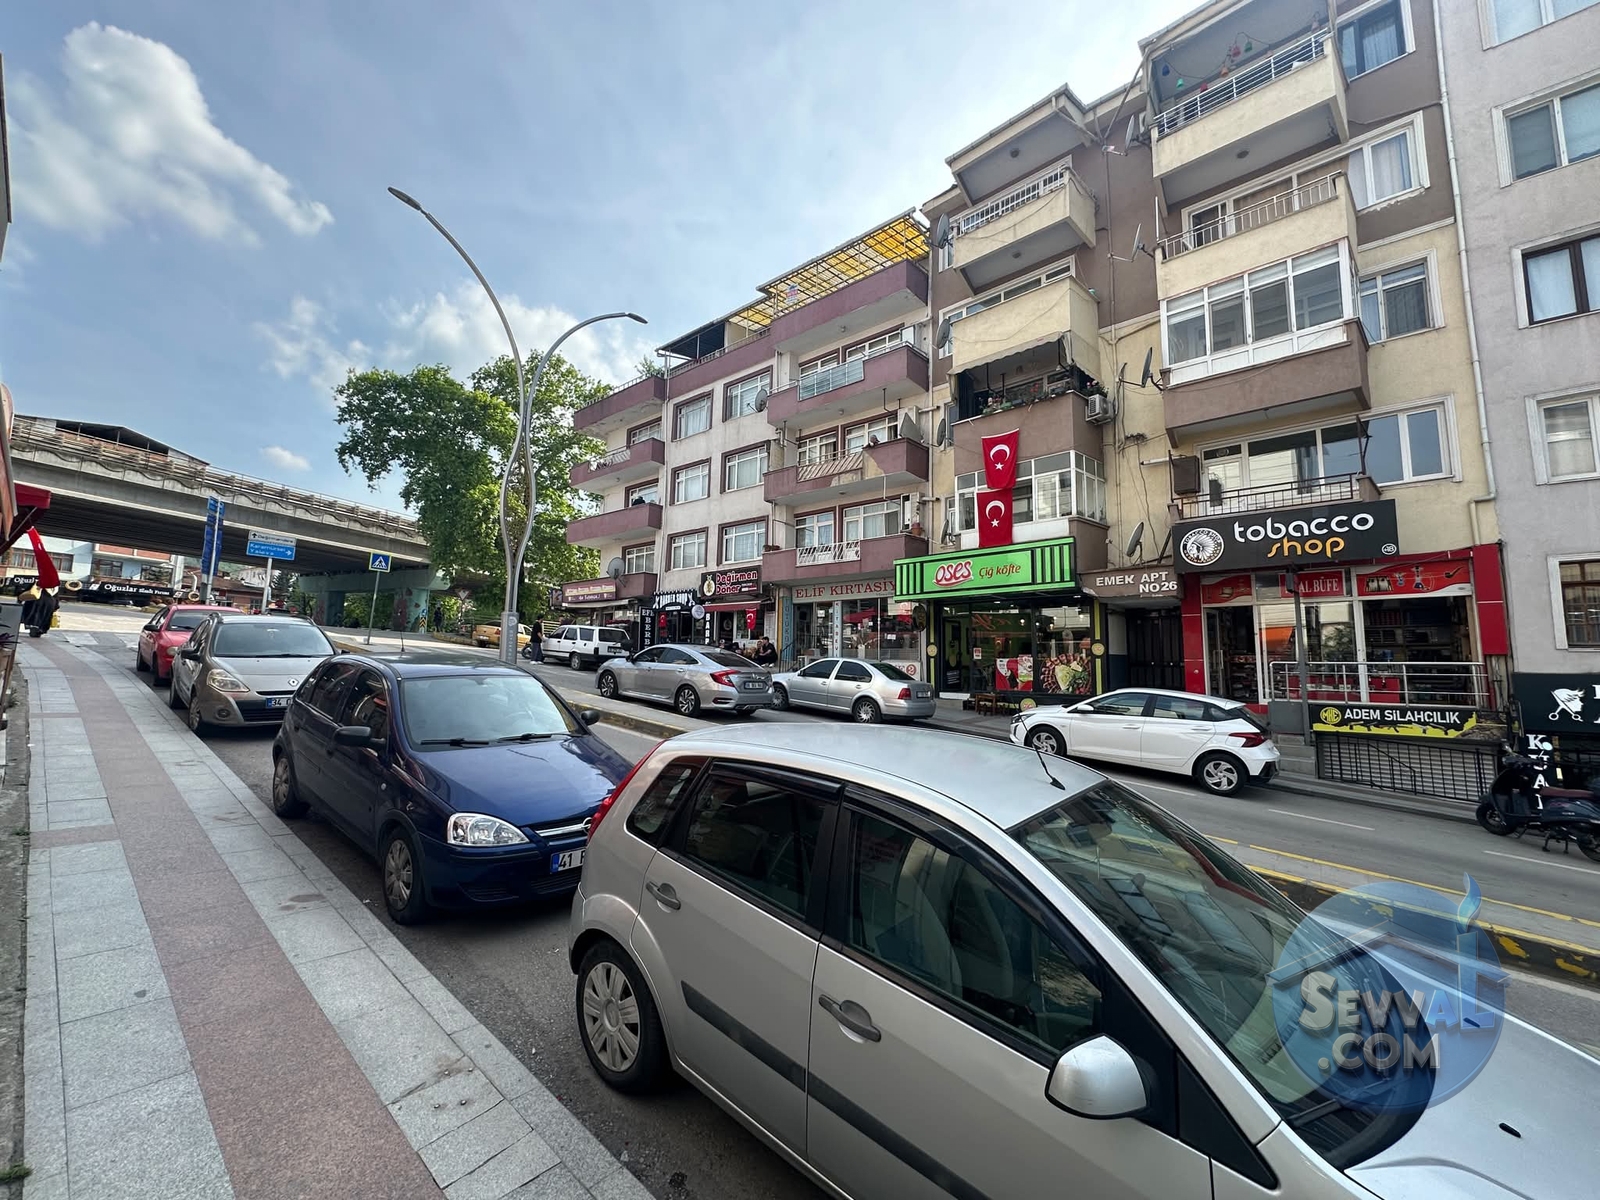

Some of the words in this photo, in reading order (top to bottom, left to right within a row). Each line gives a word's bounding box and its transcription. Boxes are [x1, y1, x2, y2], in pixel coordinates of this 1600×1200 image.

[1234, 512, 1375, 543] tobacco
[1267, 535, 1345, 559] shop
[716, 570, 758, 586] Değirmen
[996, 563, 1022, 577] köfte
[1096, 574, 1135, 587] EMEK
[1140, 571, 1169, 583] APT
[1313, 576, 1340, 592] BÜFE
[104, 583, 138, 593] Oğuzlar
[716, 584, 741, 595] Döner
[795, 581, 825, 597] ELİF
[272, 698, 282, 706] 34
[1344, 708, 1381, 721] ADEM
[558, 852, 573, 868] 41
